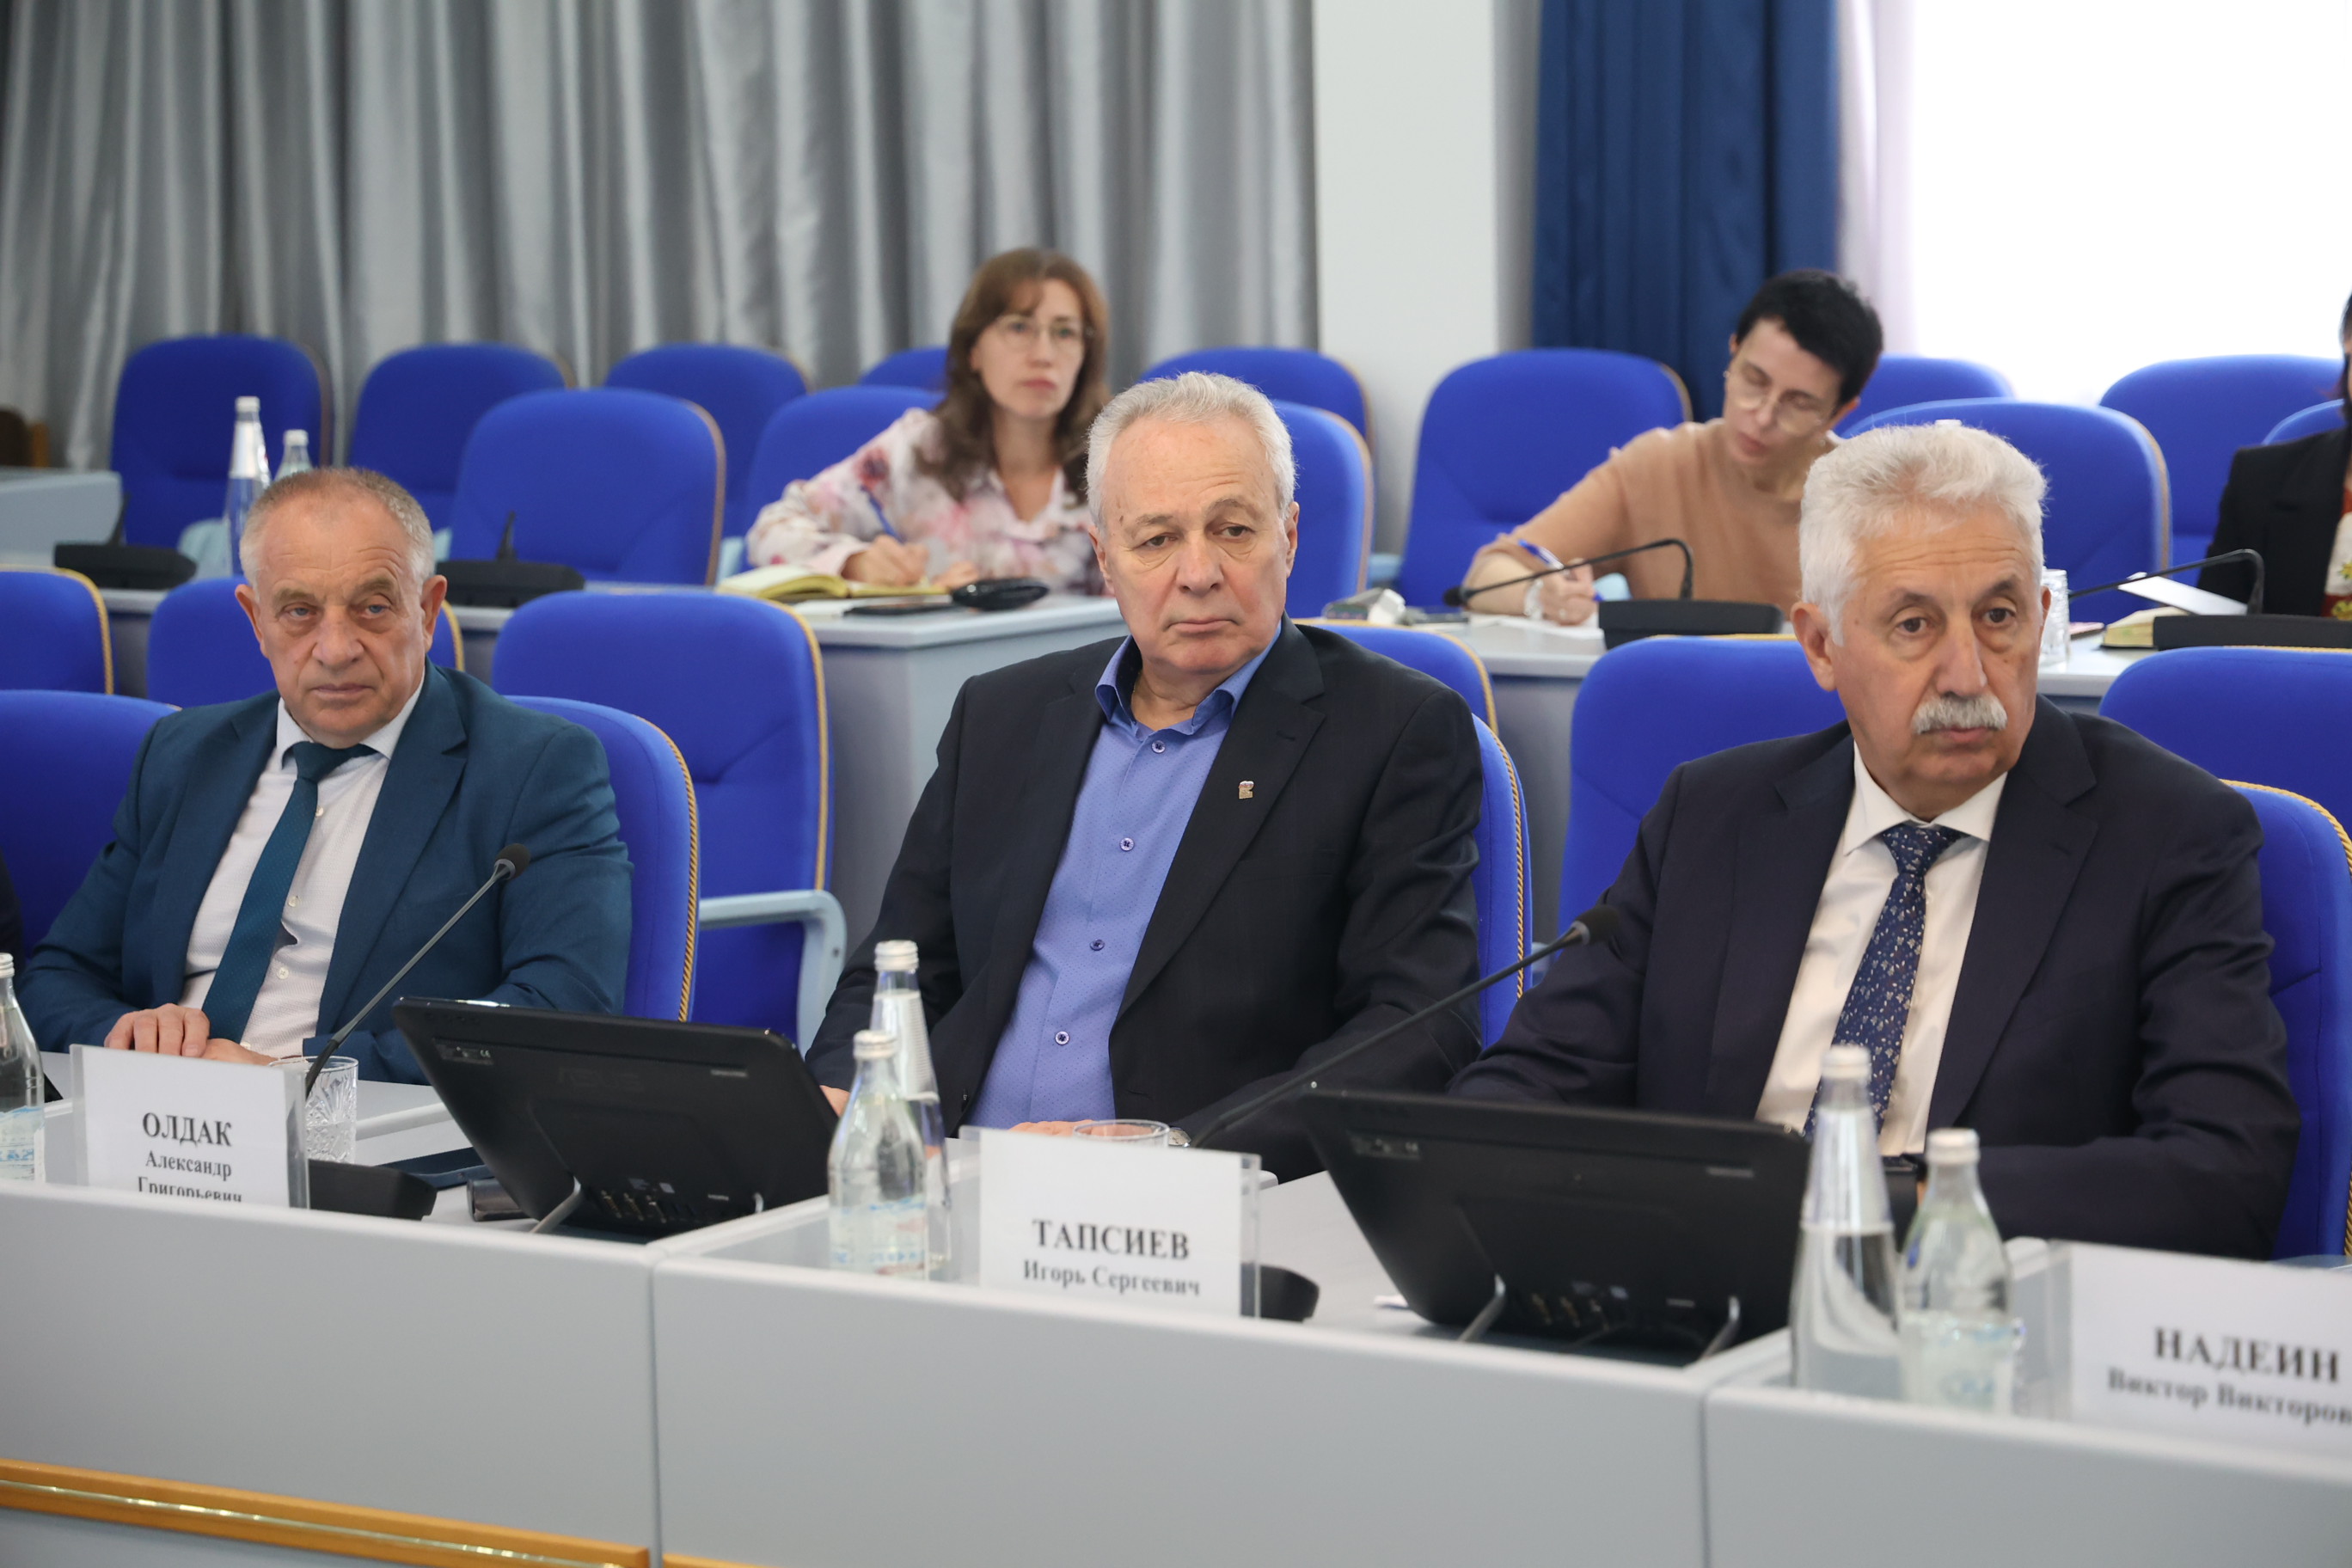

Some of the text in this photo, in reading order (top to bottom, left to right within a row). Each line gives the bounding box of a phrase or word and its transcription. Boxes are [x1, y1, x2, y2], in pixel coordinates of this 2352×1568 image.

[142, 1112, 232, 1148] ОЛДАК
[145, 1149, 232, 1181] Александр
[1032, 1218, 1190, 1261] ТАПСИЕВ
[1023, 1259, 1200, 1296] Игорь Сергеевич
[2154, 1326, 2340, 1383] НАДЕИН
[2108, 1365, 2208, 1410] Виктор
